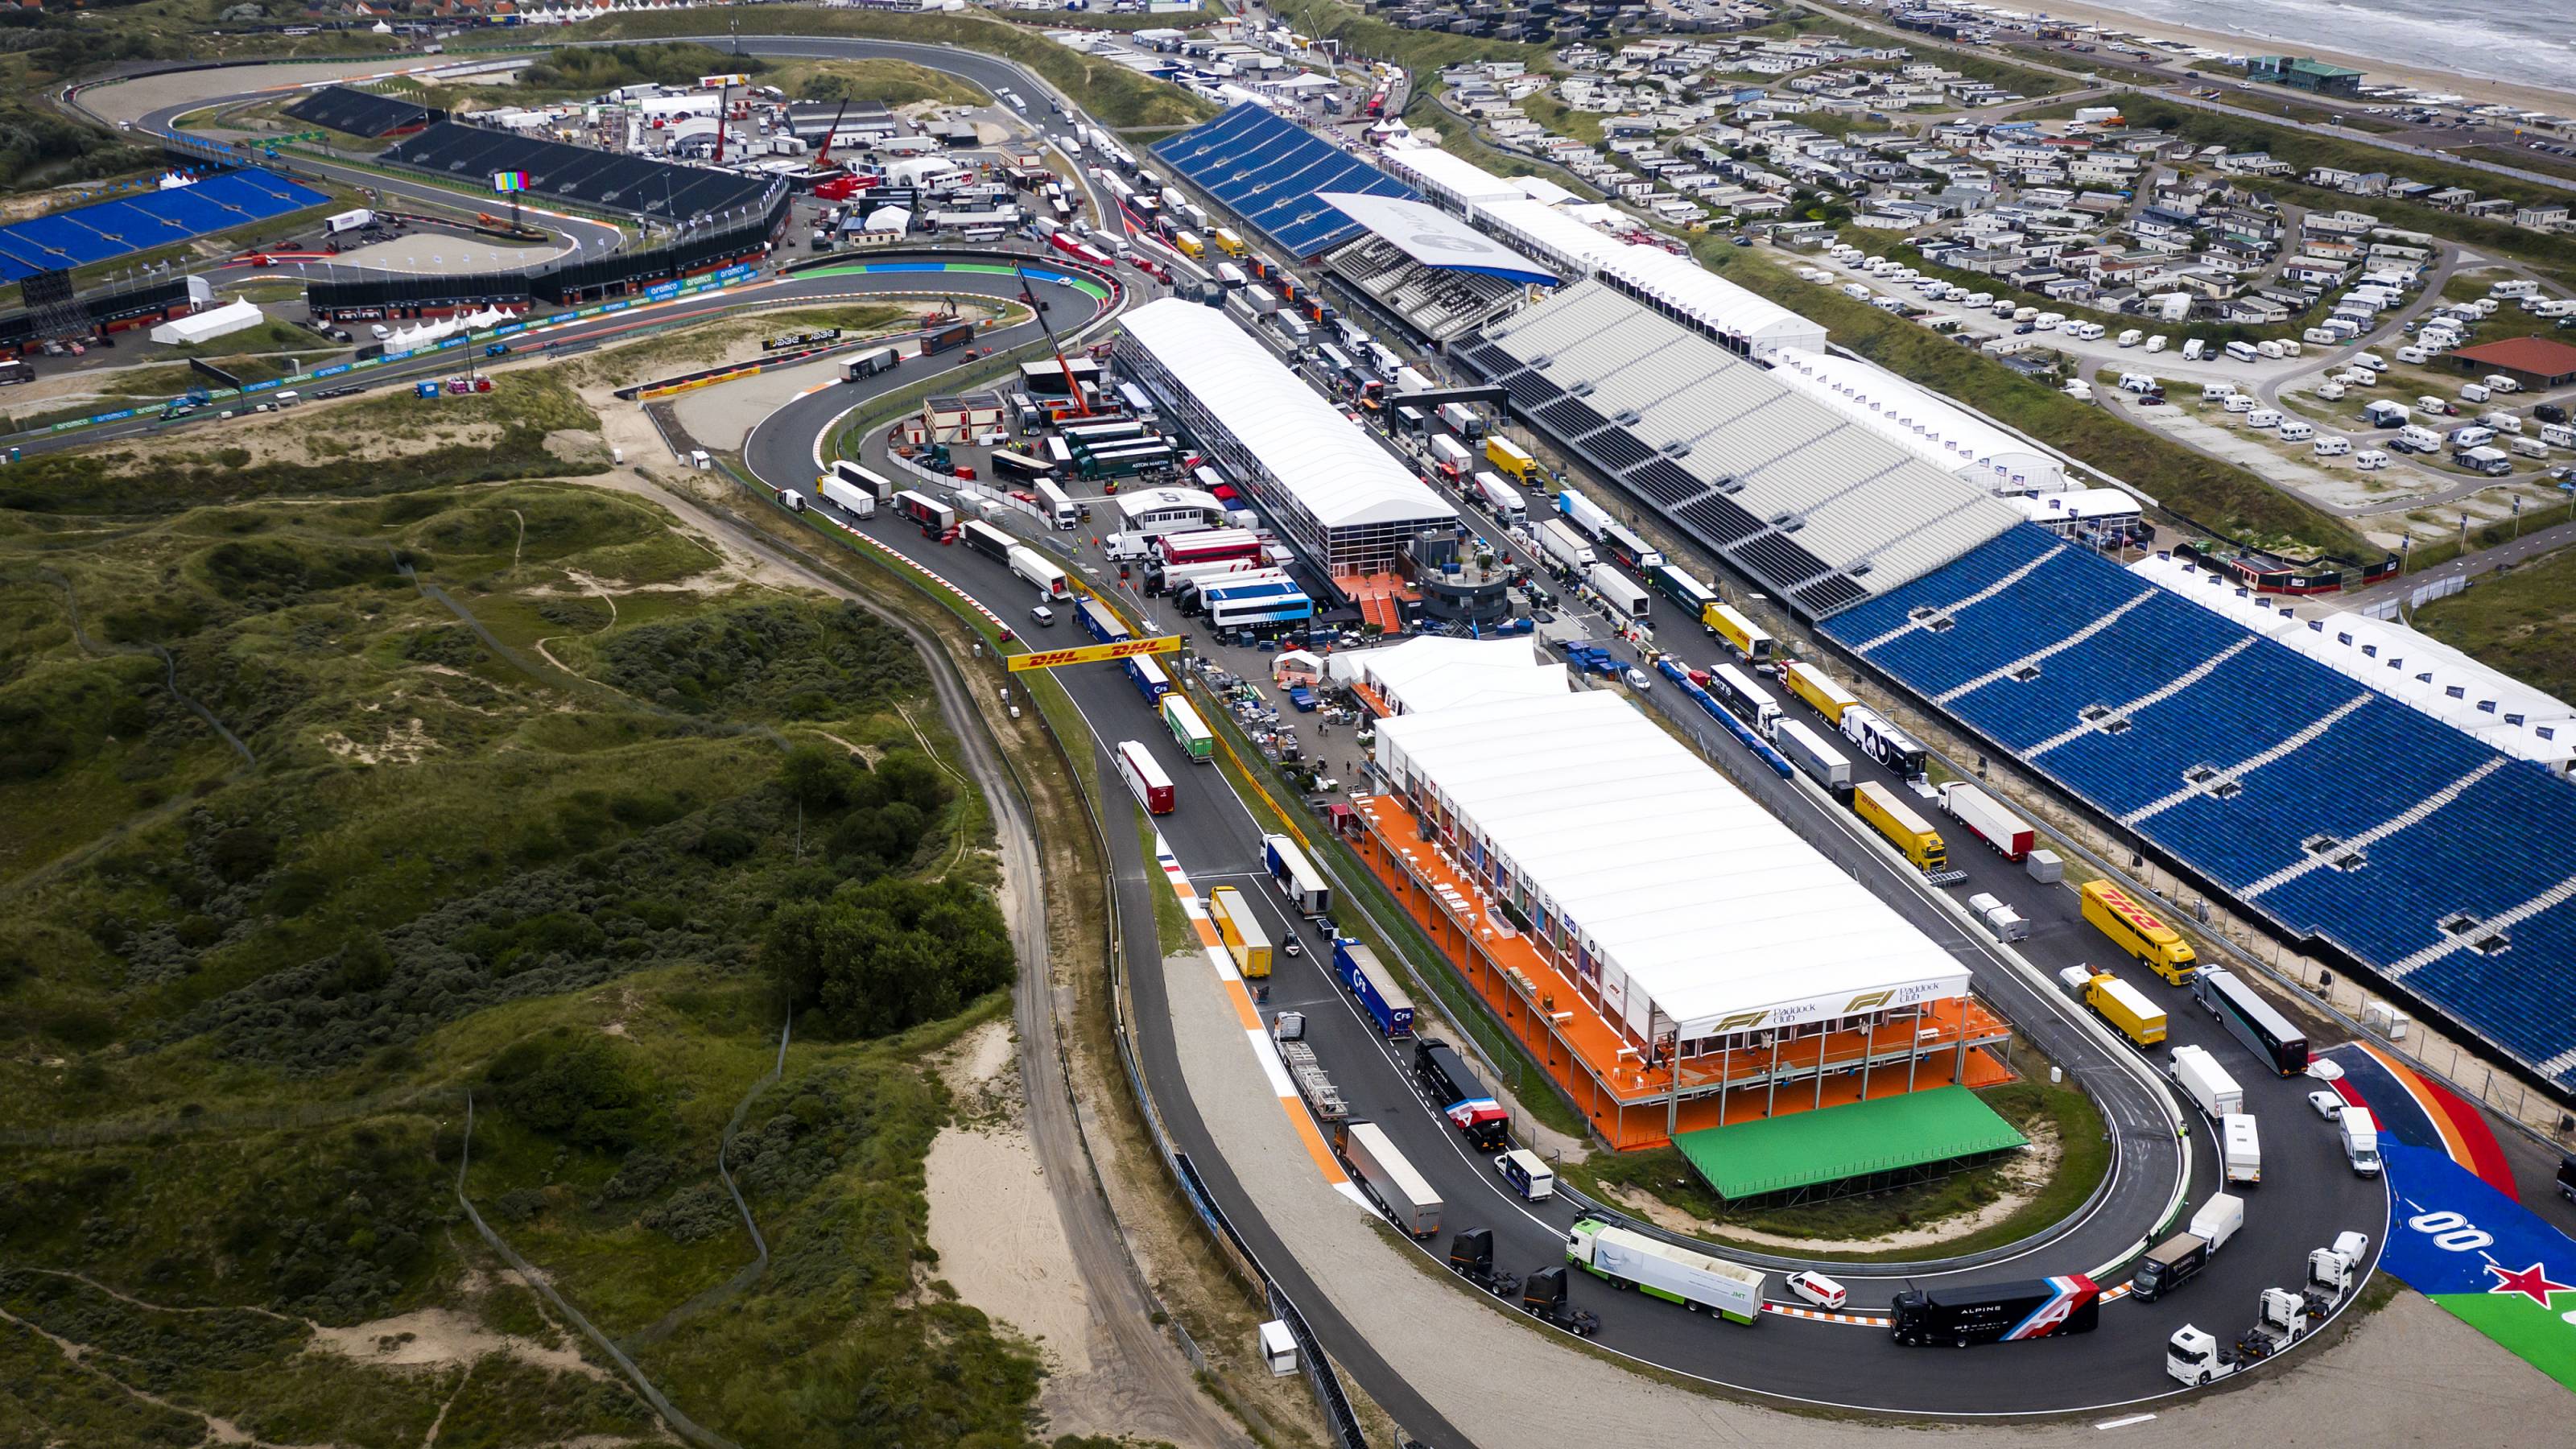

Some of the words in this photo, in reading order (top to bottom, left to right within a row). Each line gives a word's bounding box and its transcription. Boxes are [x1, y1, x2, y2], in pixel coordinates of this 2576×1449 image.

[687, 275, 712, 286] aramco
[720, 266, 745, 278] aramco
[651, 283, 678, 295] aramco
[1132, 461, 1149, 469] ASTON
[1150, 460, 1169, 468] MARTIN
[1029, 651, 1079, 667] DHL
[1111, 641, 1160, 657] DHL
[1154, 685, 1167, 693] CFS
[1860, 795, 1880, 814] DHL
[1503, 852, 1513, 869] 22
[1522, 870, 1534, 891] 18
[2099, 889, 2165, 931] DHL
[1563, 913, 1576, 931] 99
[1352, 968, 1366, 993] CFS
[1842, 989, 1897, 1013] F1
[1899, 981, 1939, 996] Paddock
[1393, 1012, 1411, 1022] CFS
[1711, 1010, 1771, 1034] F1
[1773, 1003, 1816, 1016] Paddock
[1731, 1290, 1746, 1300] JMT
[1961, 1305, 2002, 1315] ALPINE
